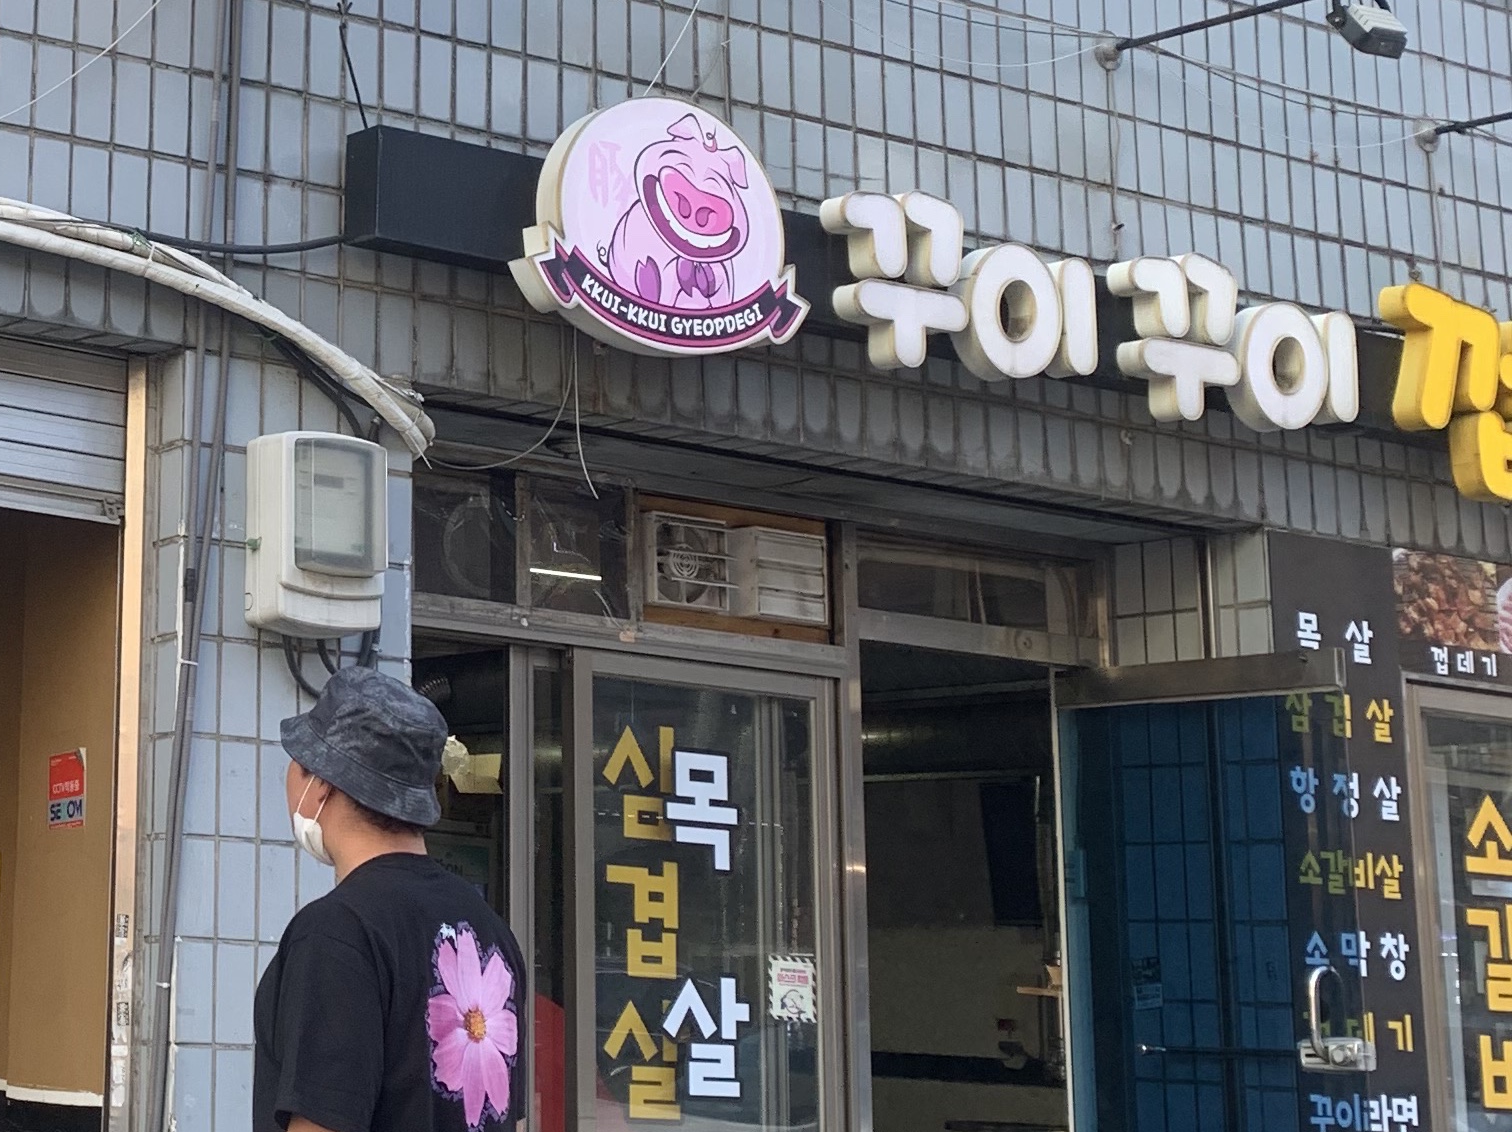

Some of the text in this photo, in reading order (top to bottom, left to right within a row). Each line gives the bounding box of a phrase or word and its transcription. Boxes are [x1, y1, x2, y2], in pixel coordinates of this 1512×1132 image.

[581, 274, 764, 337] KKUI-KKUI GYEOPDEGI
[1430, 646, 1498, 678] 껍데기
[1285, 692, 1395, 744] 삼겹살
[1290, 765, 1402, 822] 항정살
[1299, 850, 1404, 900] 소갈비살
[1306, 931, 1410, 981] 소막창
